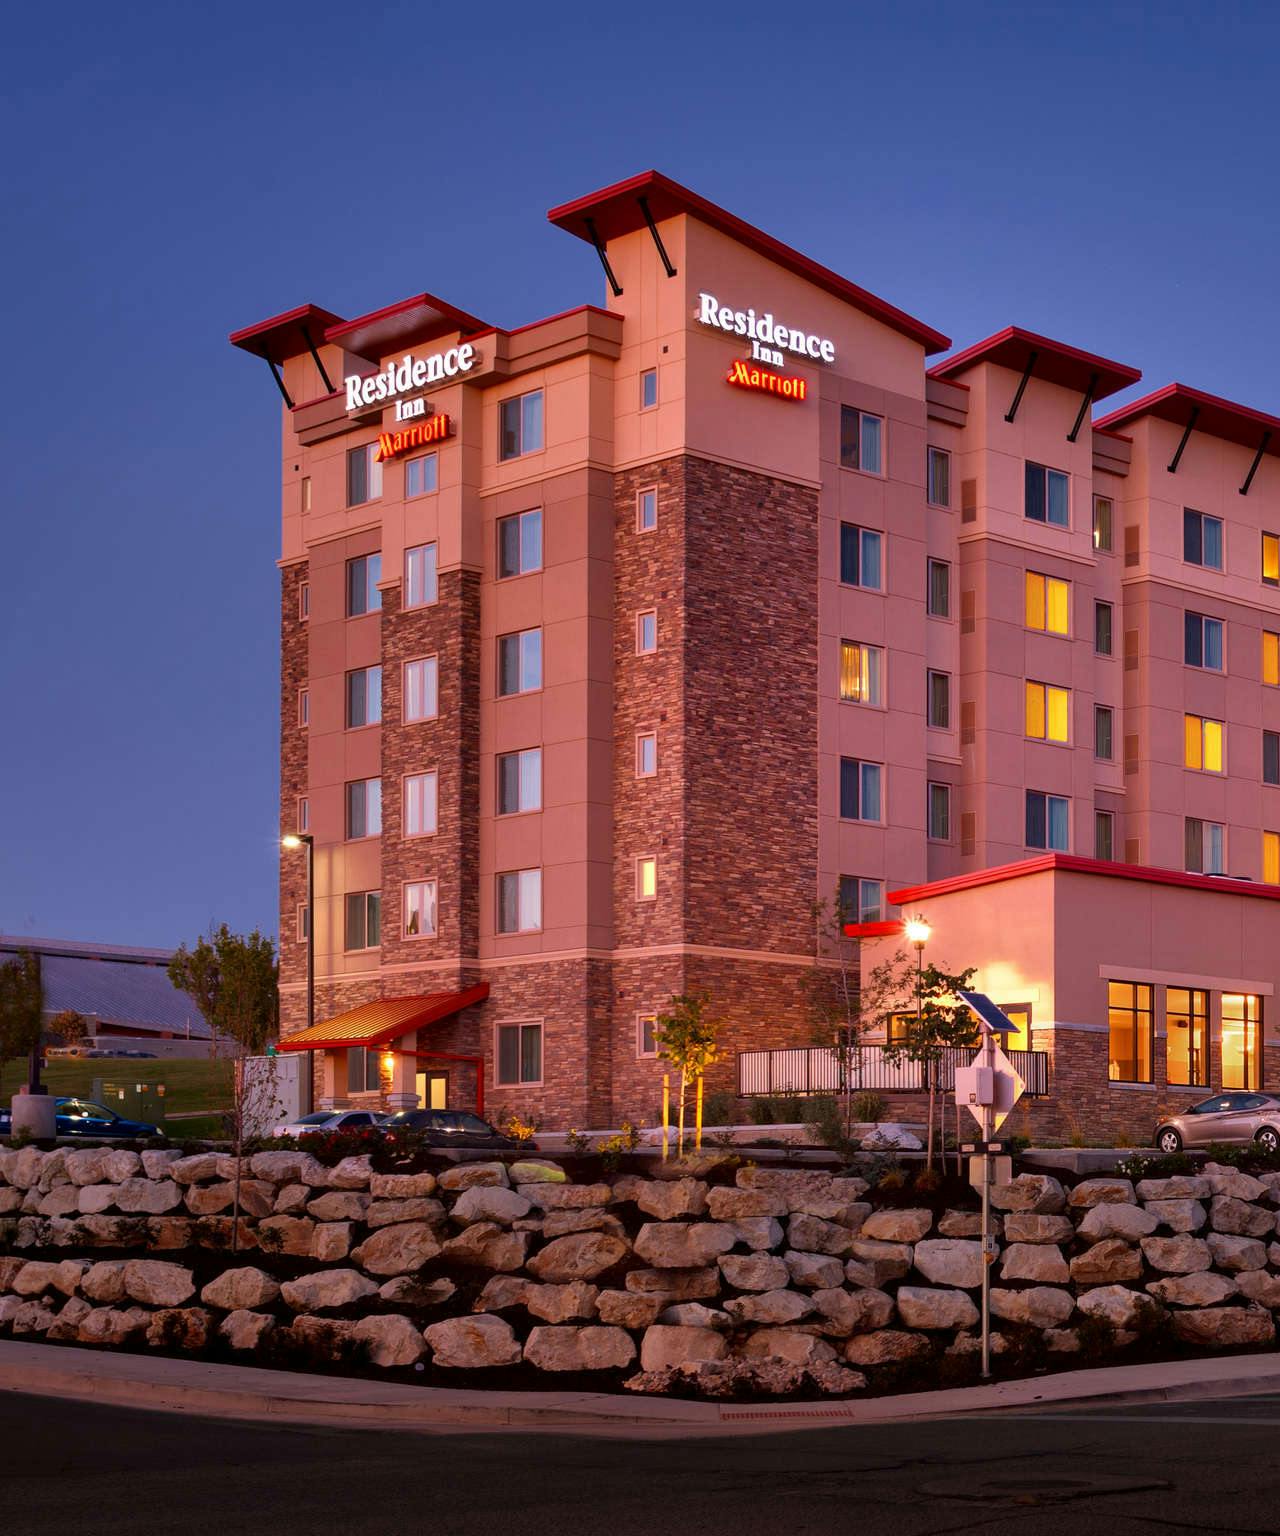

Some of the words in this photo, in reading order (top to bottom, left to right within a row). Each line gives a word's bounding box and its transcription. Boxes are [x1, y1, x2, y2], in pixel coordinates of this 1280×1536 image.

[699, 292, 835, 362] Residence
[752, 340, 785, 367] Inn
[344, 343, 473, 411] Residence
[728, 361, 806, 399] Marriott
[395, 397, 425, 422] Inn
[375, 414, 449, 462] Marriott
